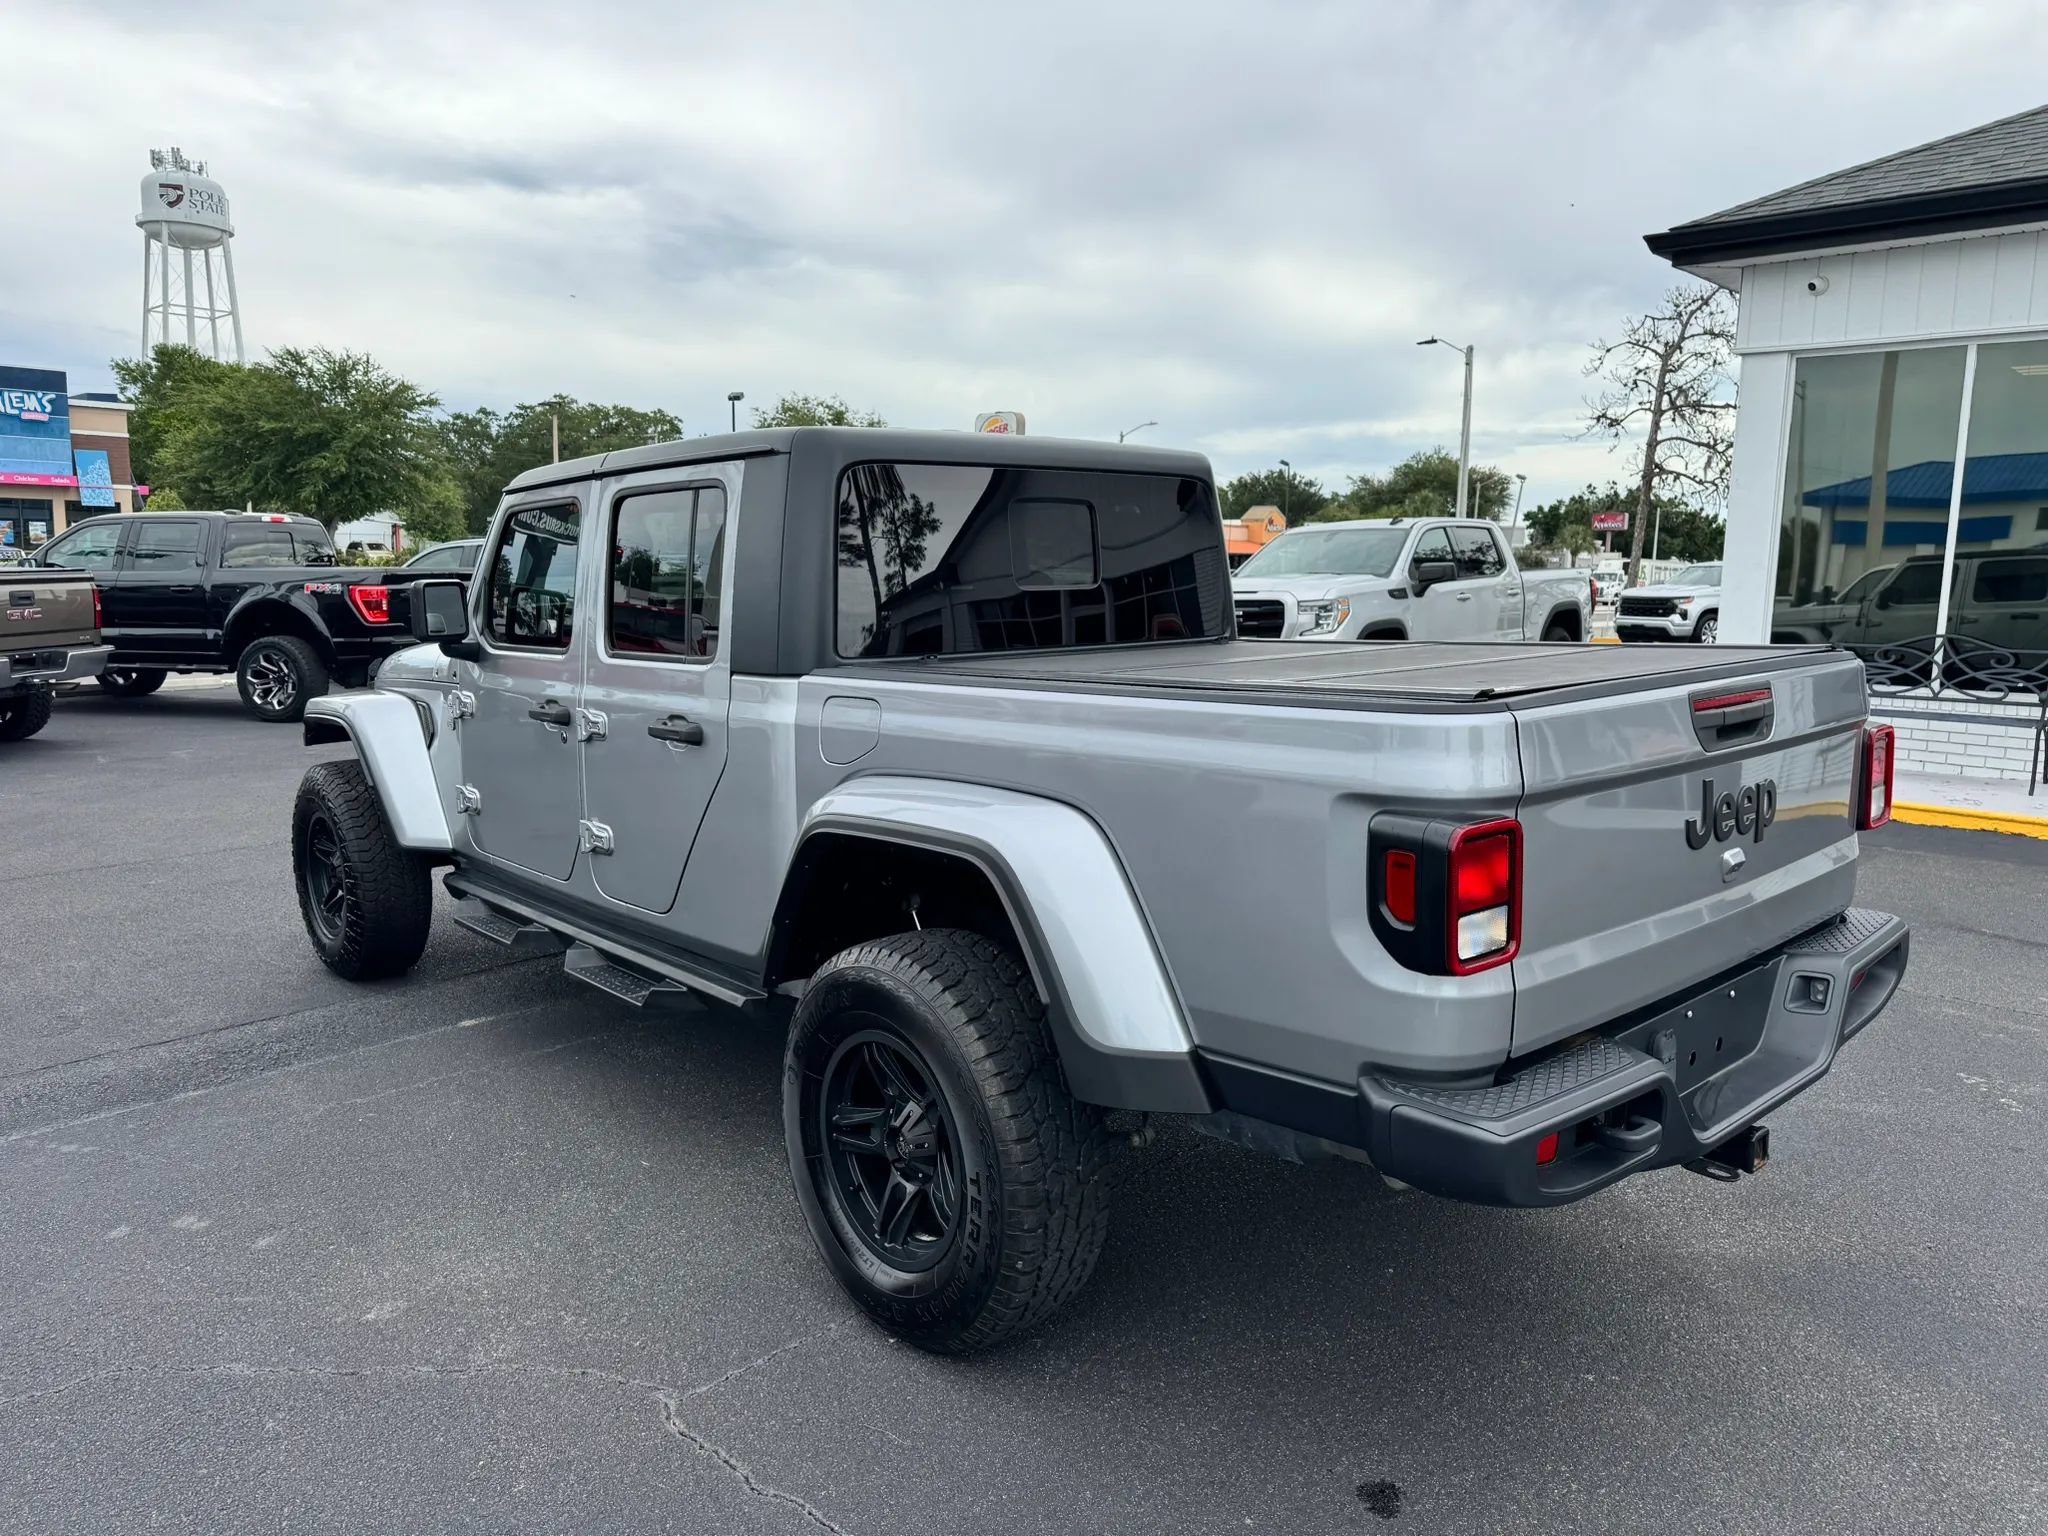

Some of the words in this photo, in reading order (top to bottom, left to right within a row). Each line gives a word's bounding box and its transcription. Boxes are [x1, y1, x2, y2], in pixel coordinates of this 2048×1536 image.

[189, 188, 224, 207] POLK
[189, 199, 225, 216] STATE
[13, 475, 39, 483] Chicken
[304, 583, 342, 594] FX4
[7, 607, 43, 621] GMC
[1685, 777, 1777, 851] Jeep
